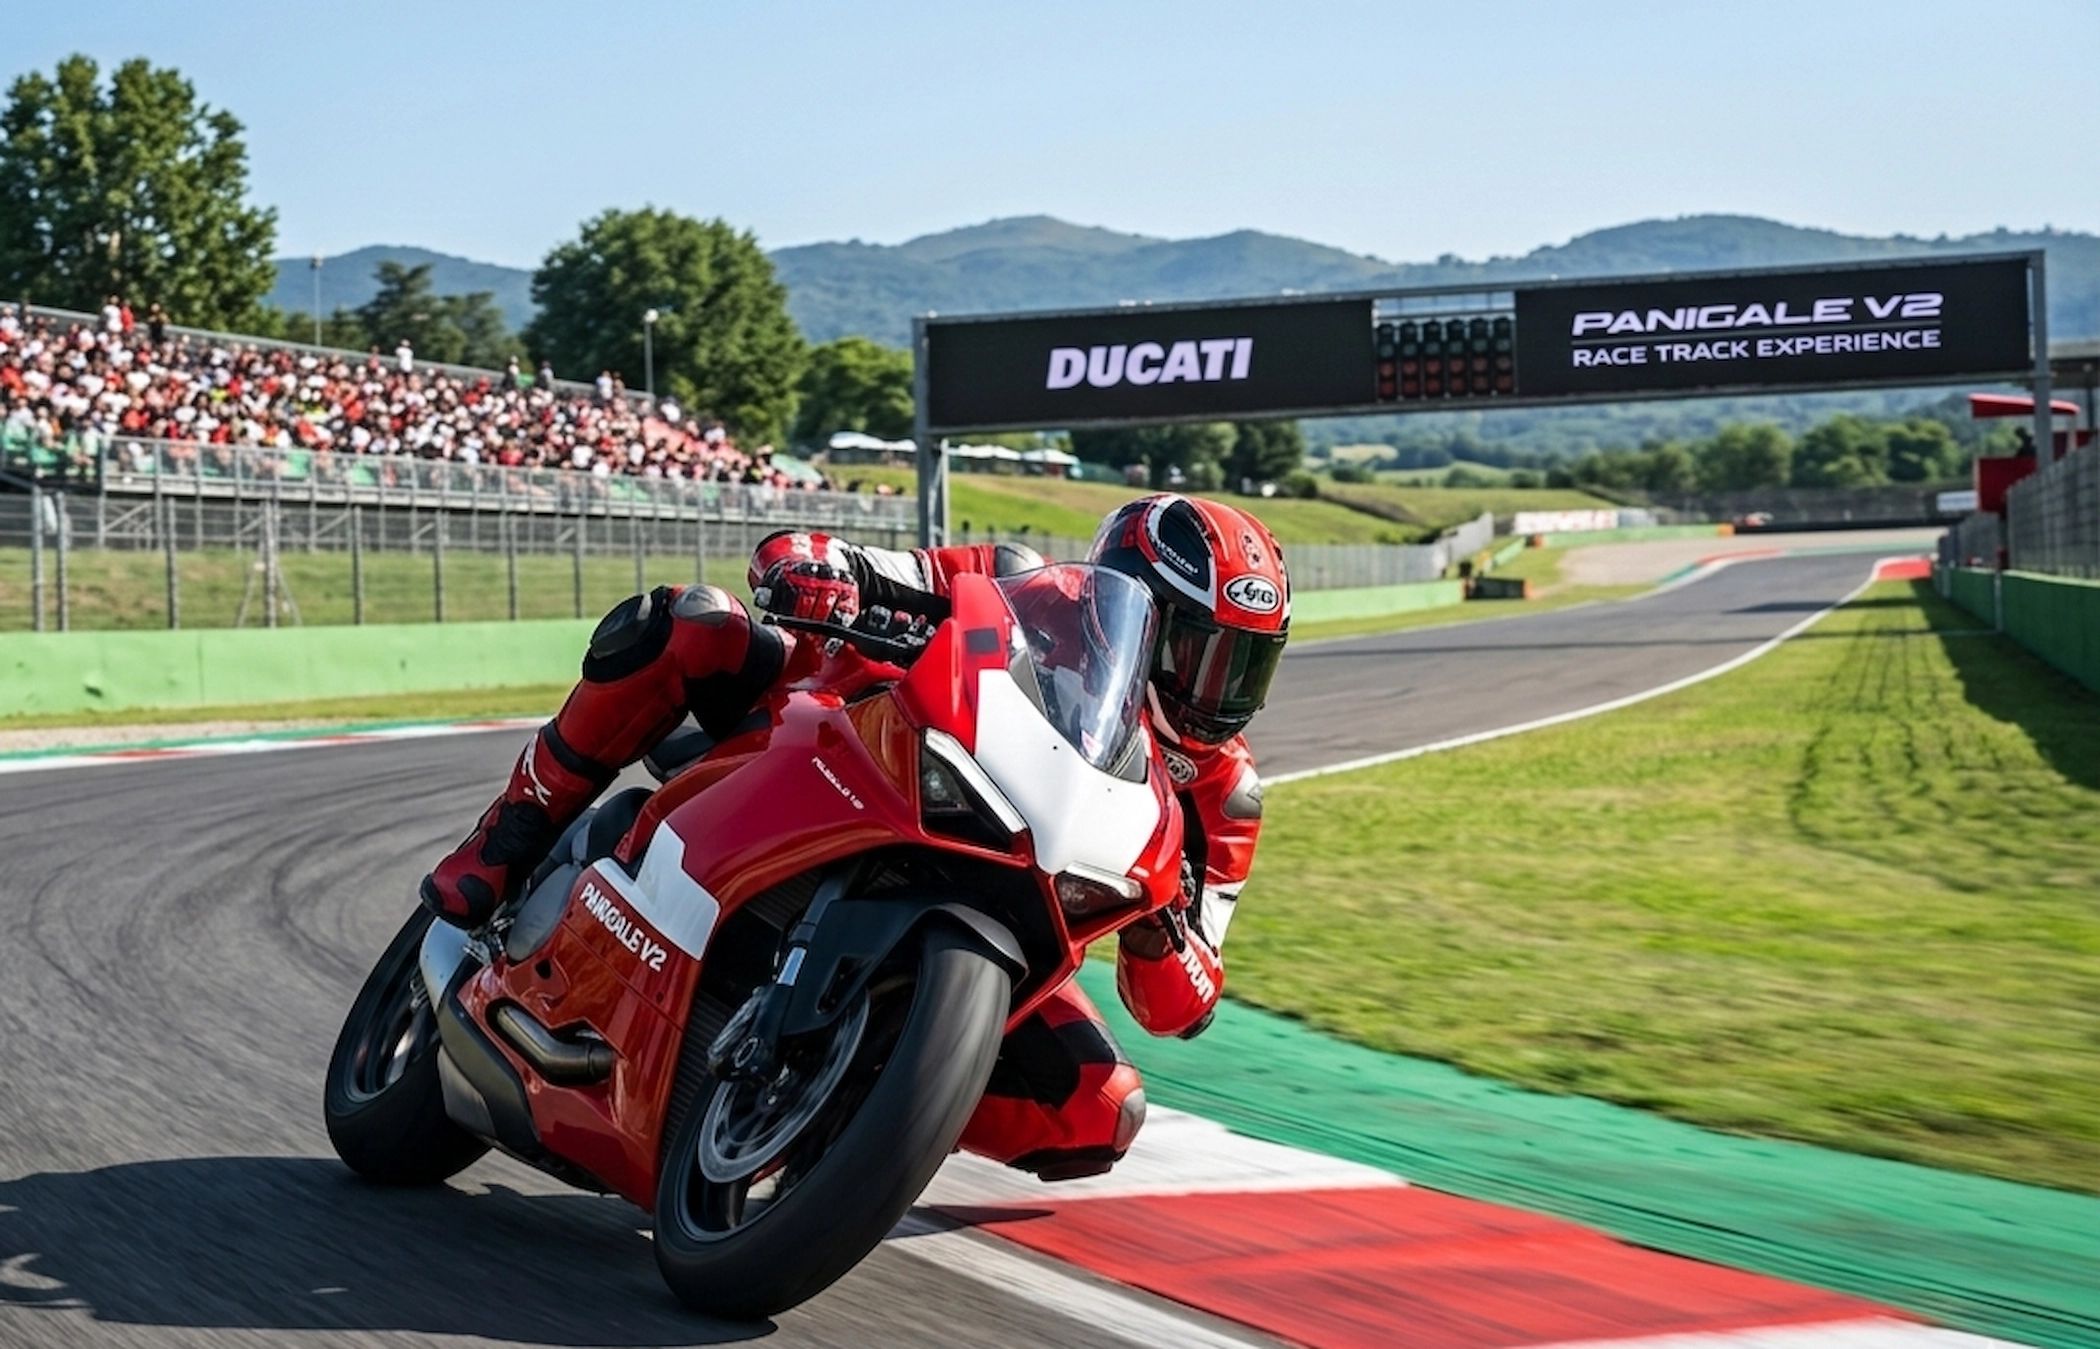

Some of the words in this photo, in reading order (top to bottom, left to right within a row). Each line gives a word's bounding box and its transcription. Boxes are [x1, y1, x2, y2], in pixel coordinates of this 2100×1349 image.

[1571, 298, 1854, 336] PANIGALE
[1863, 292, 1944, 319] V2
[1046, 338, 1253, 389] DUCATI
[1573, 346, 1648, 367] RACE
[1654, 340, 1750, 363] TRACK
[1756, 329, 1942, 358] EXPERIENCE
[639, 937, 668, 973] V2
